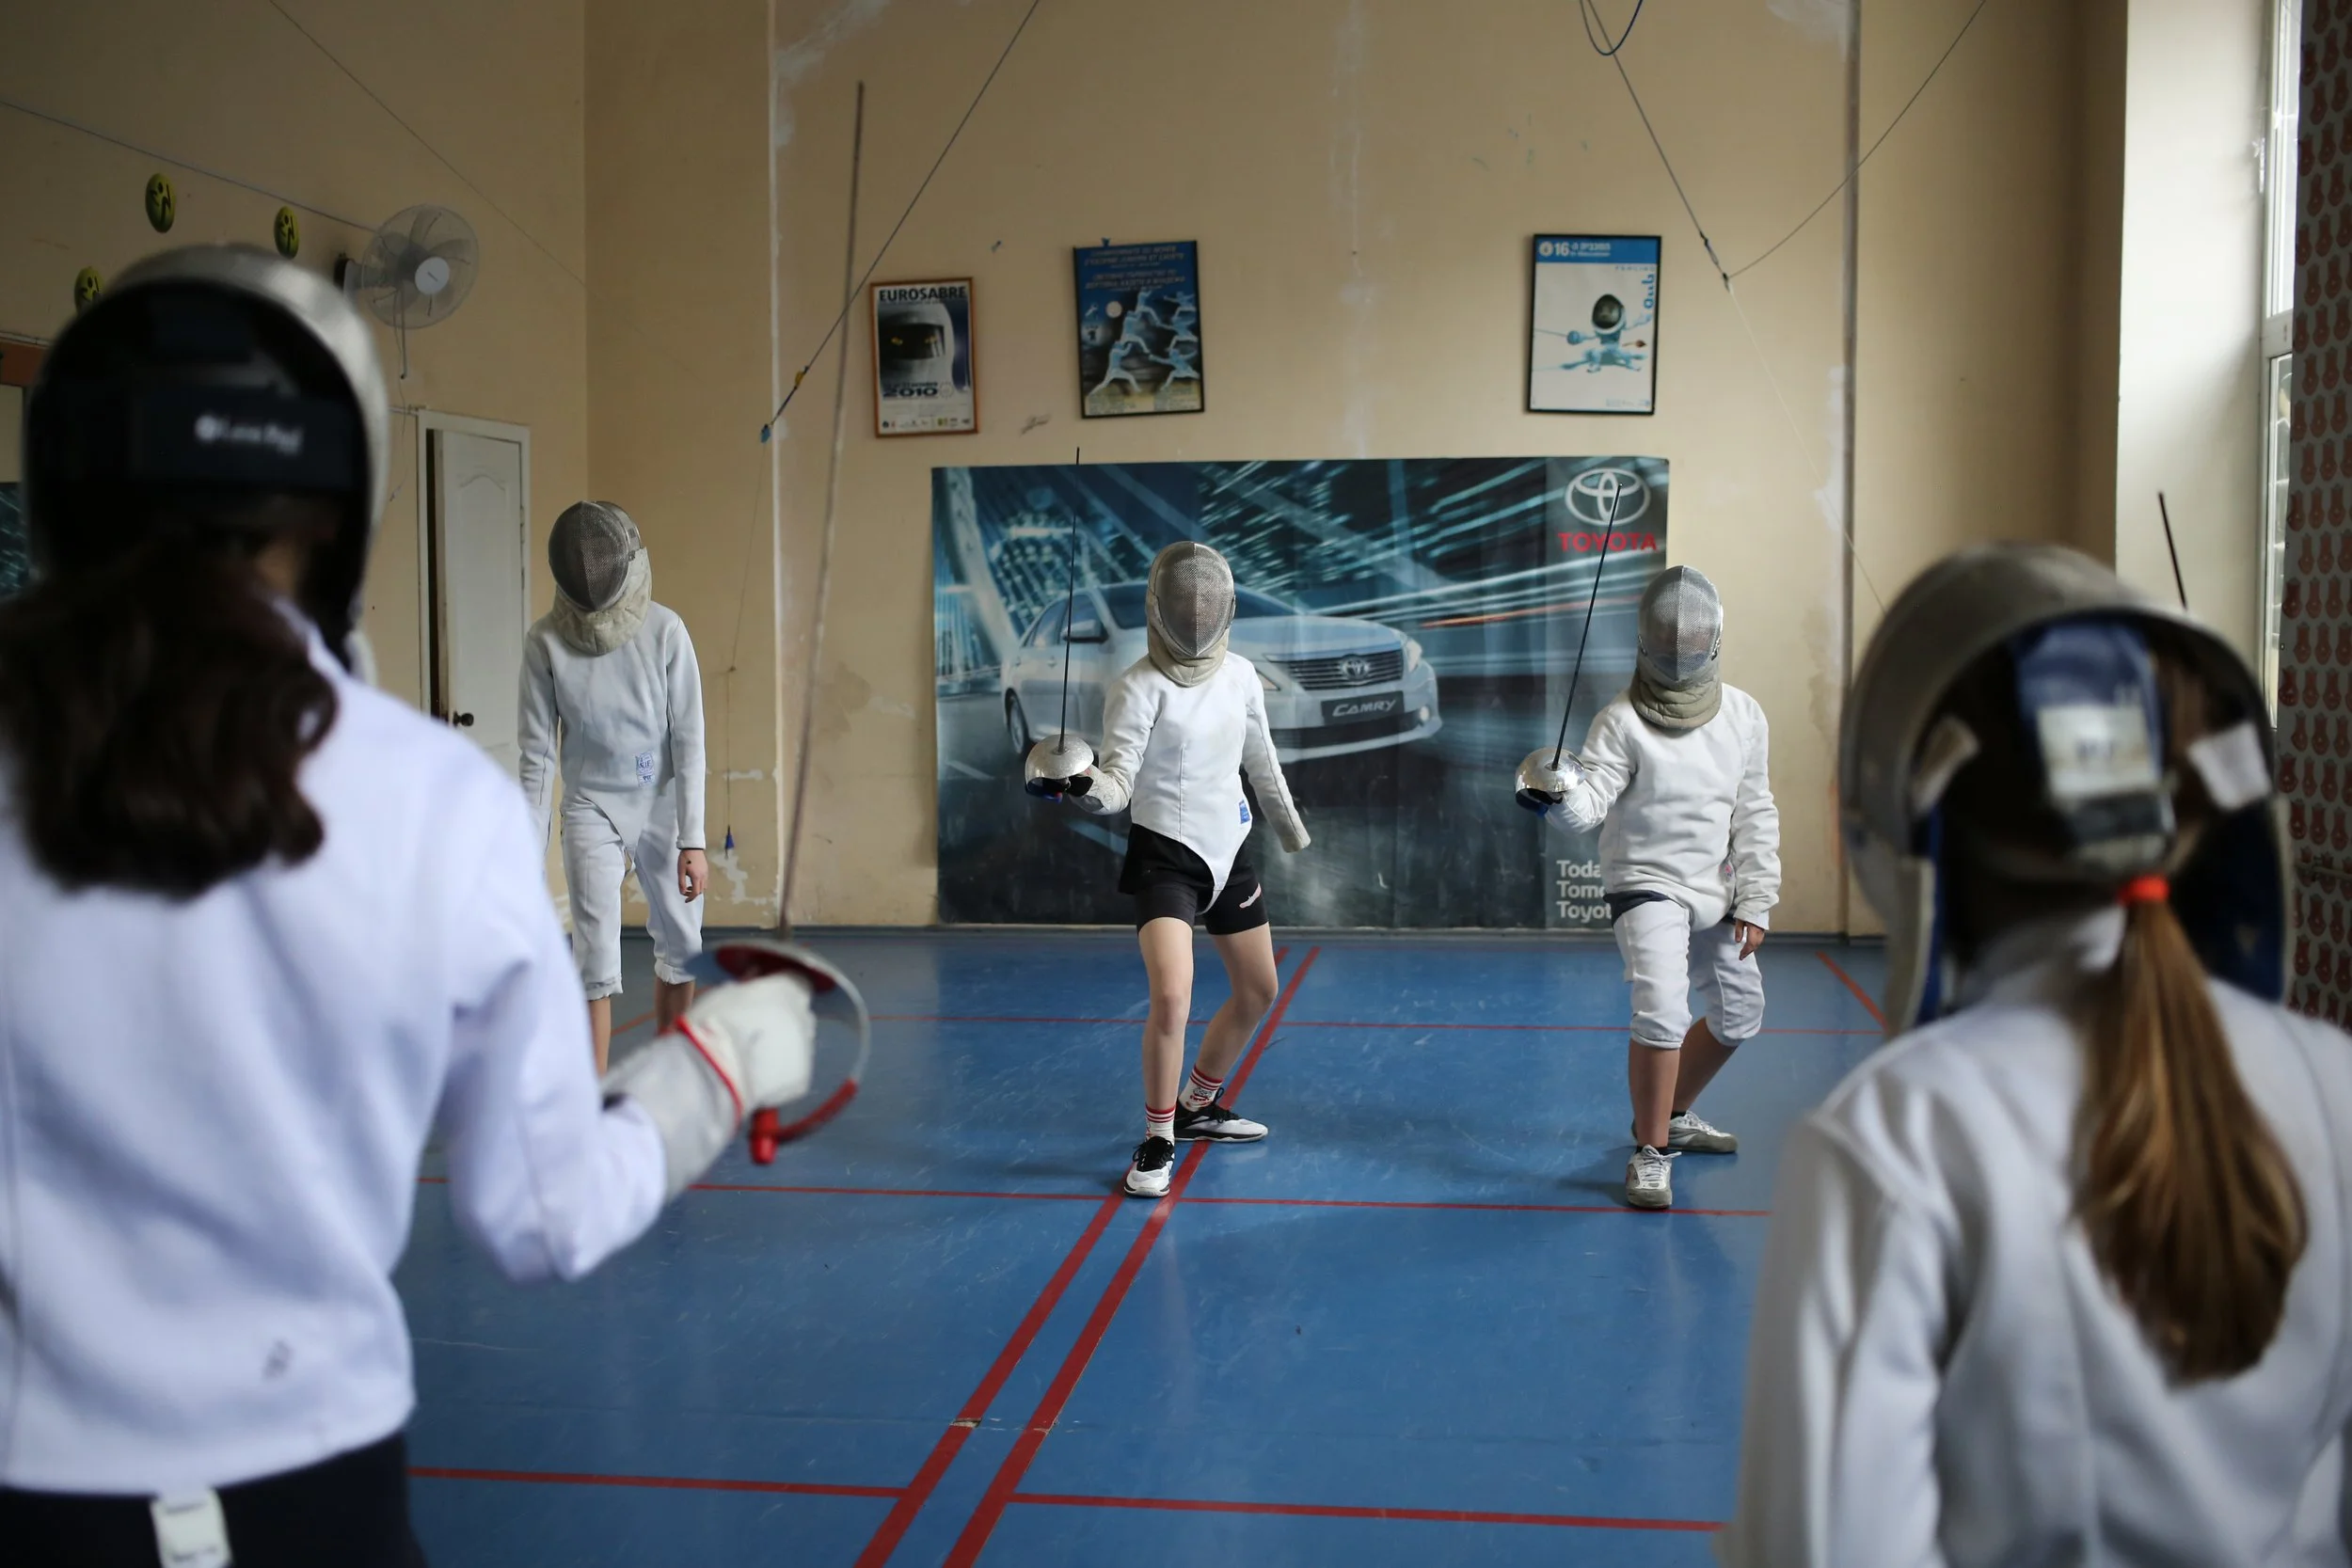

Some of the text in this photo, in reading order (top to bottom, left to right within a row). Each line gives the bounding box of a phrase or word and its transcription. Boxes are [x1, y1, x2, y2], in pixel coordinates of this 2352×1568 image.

[1554, 241, 1570, 257] 16
[879, 286, 967, 302] EUROSABRE
[883, 387, 938, 397] 2010
[1557, 531, 1657, 553] TOYOTA
[1332, 699, 1397, 717] CAMRY
[1556, 860, 1601, 878] Toda
[1556, 900, 1612, 923] Toyot
